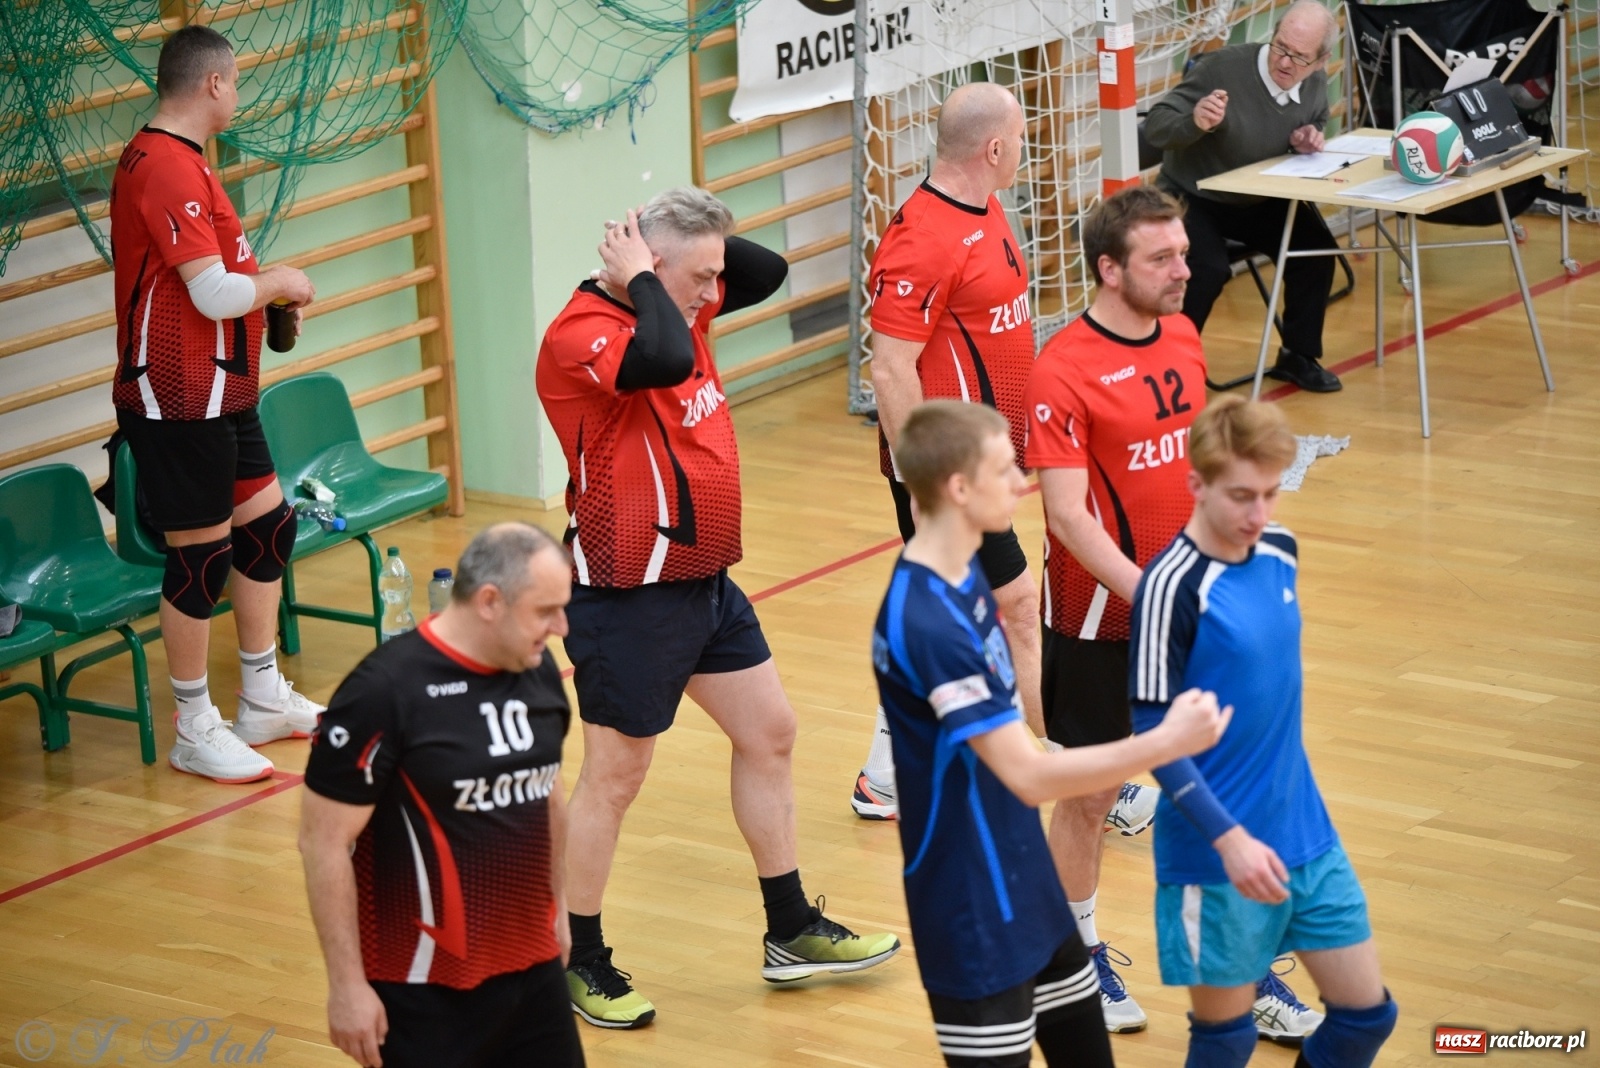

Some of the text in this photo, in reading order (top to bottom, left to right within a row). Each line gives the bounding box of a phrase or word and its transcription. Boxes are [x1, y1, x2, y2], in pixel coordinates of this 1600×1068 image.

[1406, 146, 1426, 175] RLPS
[1002, 238, 1021, 278] 4
[1143, 368, 1192, 421] 12
[1128, 426, 1192, 471] ZŁOT
[479, 699, 534, 757] 10
